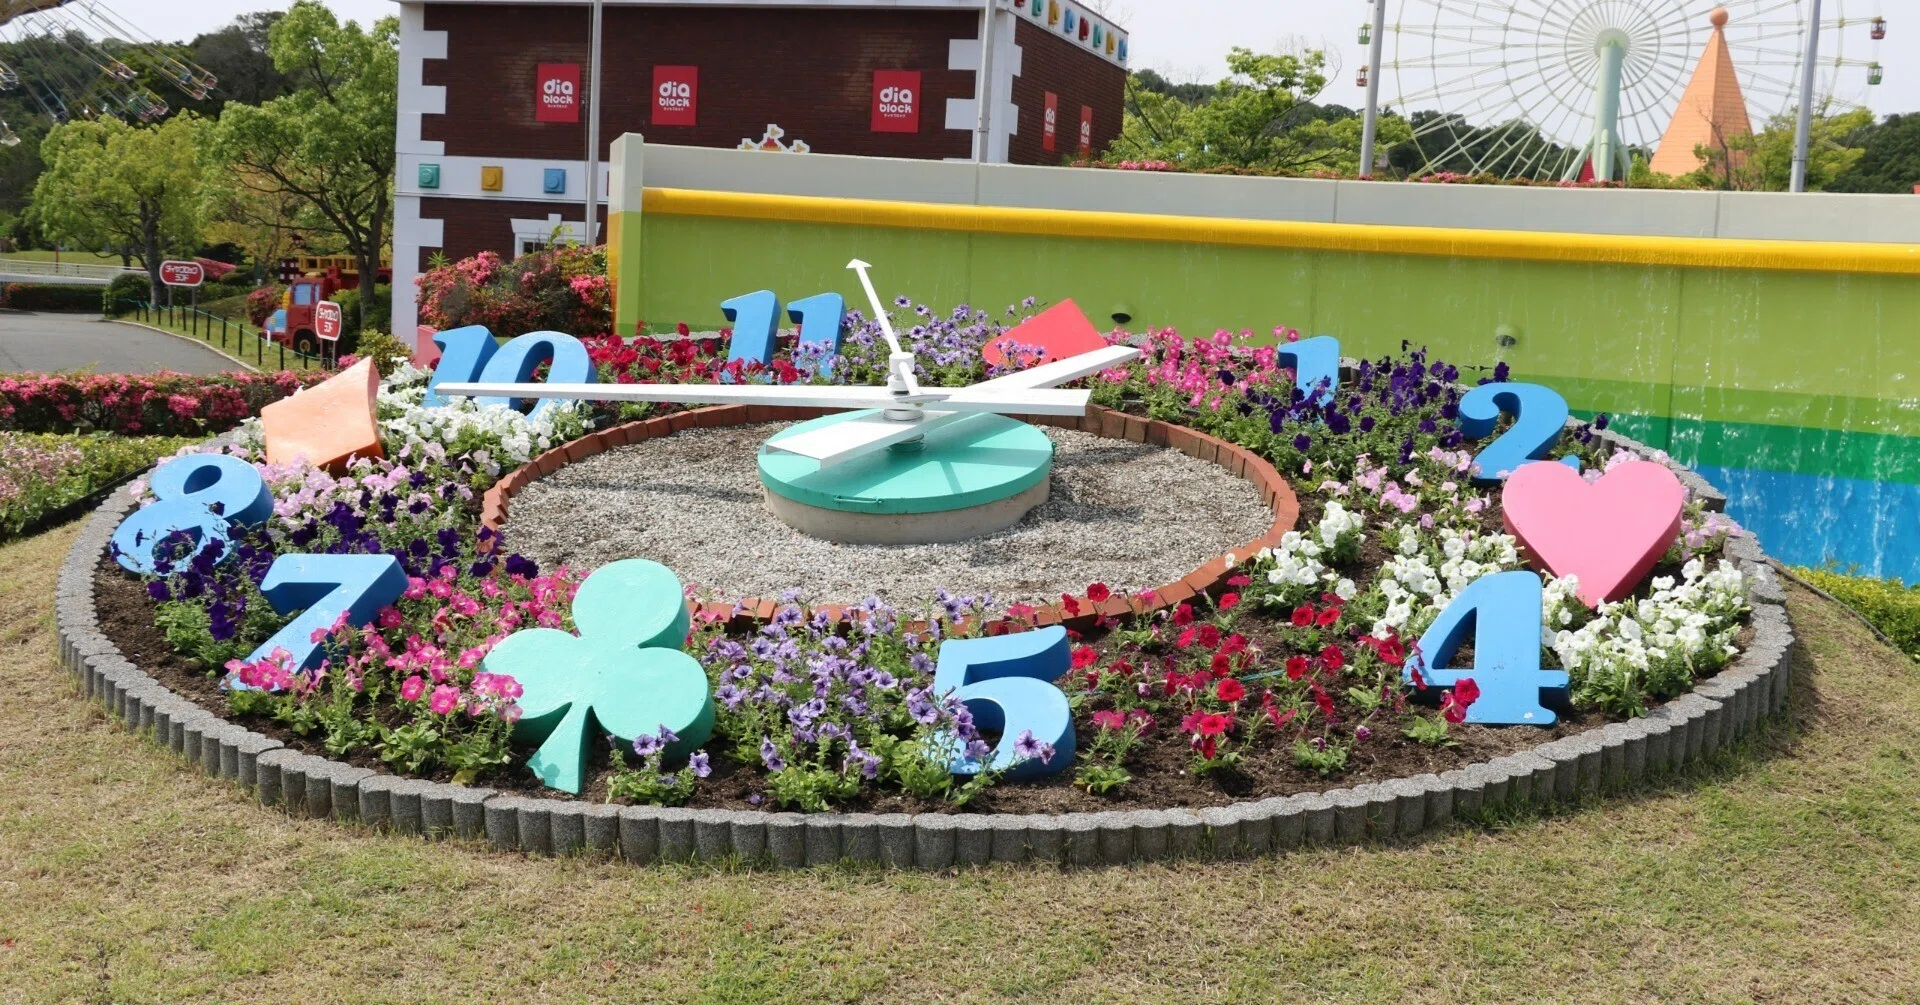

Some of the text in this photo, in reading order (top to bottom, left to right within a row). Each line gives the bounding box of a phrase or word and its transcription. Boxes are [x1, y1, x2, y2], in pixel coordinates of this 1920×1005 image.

[543, 79, 573, 95] dia
[543, 95, 573, 104] block
[659, 81, 690, 97] dia
[659, 97, 690, 107] block
[880, 87, 912, 103] dia
[880, 103, 912, 114] block
[424, 325, 598, 420] 10
[720, 290, 846, 385] 11
[1277, 336, 1340, 422] 1
[1458, 382, 1581, 481] 2
[110, 453, 274, 577] 8
[220, 553, 409, 692] 7
[1401, 571, 1569, 726] 4
[934, 625, 1077, 779] 5
